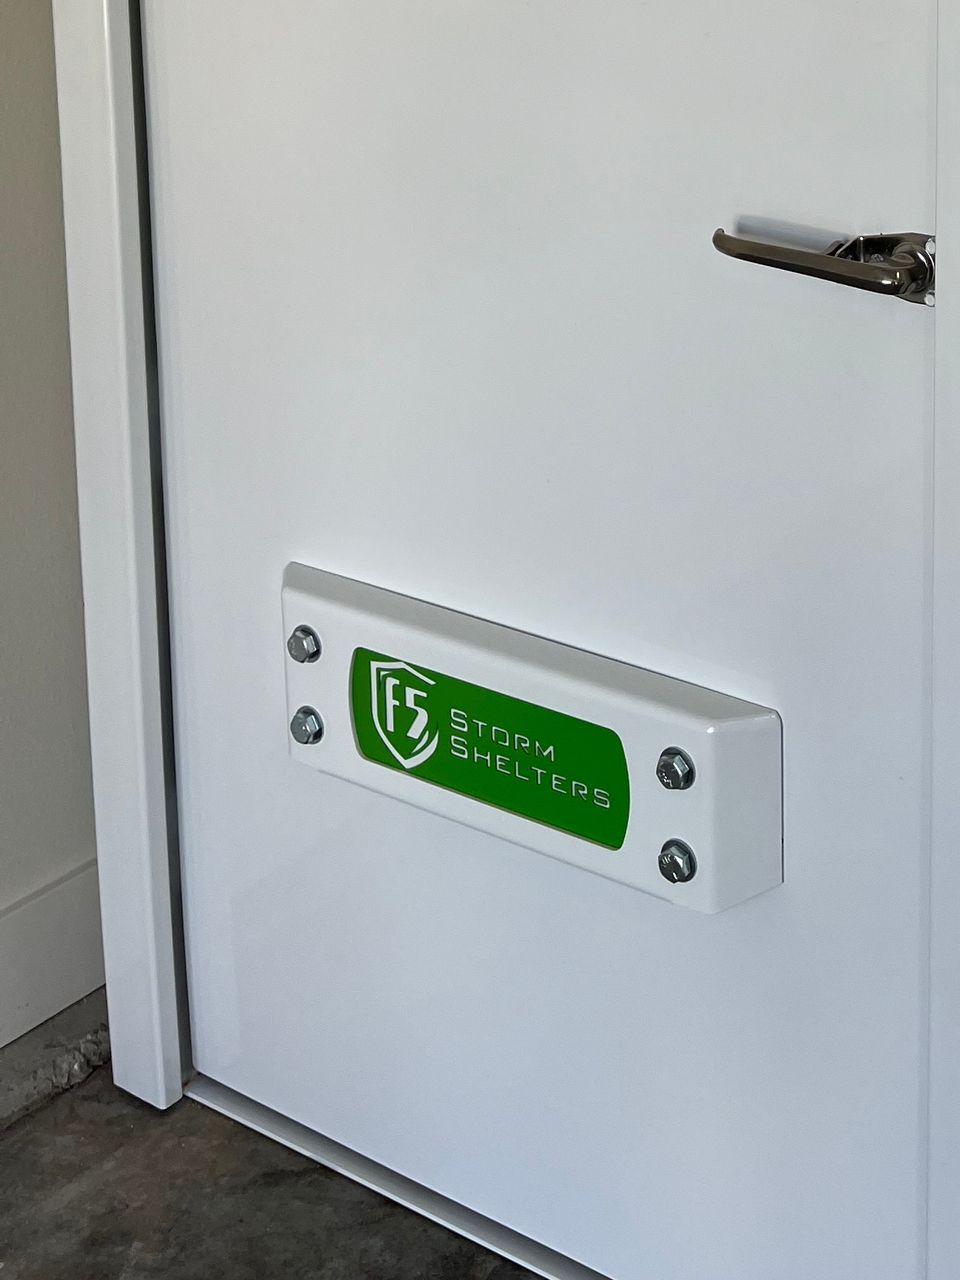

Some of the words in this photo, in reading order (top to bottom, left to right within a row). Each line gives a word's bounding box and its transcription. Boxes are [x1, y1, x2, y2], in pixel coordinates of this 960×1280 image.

[385, 676, 428, 740] F5
[450, 708, 555, 762] STORM
[450, 735, 611, 809] SHELTERS
